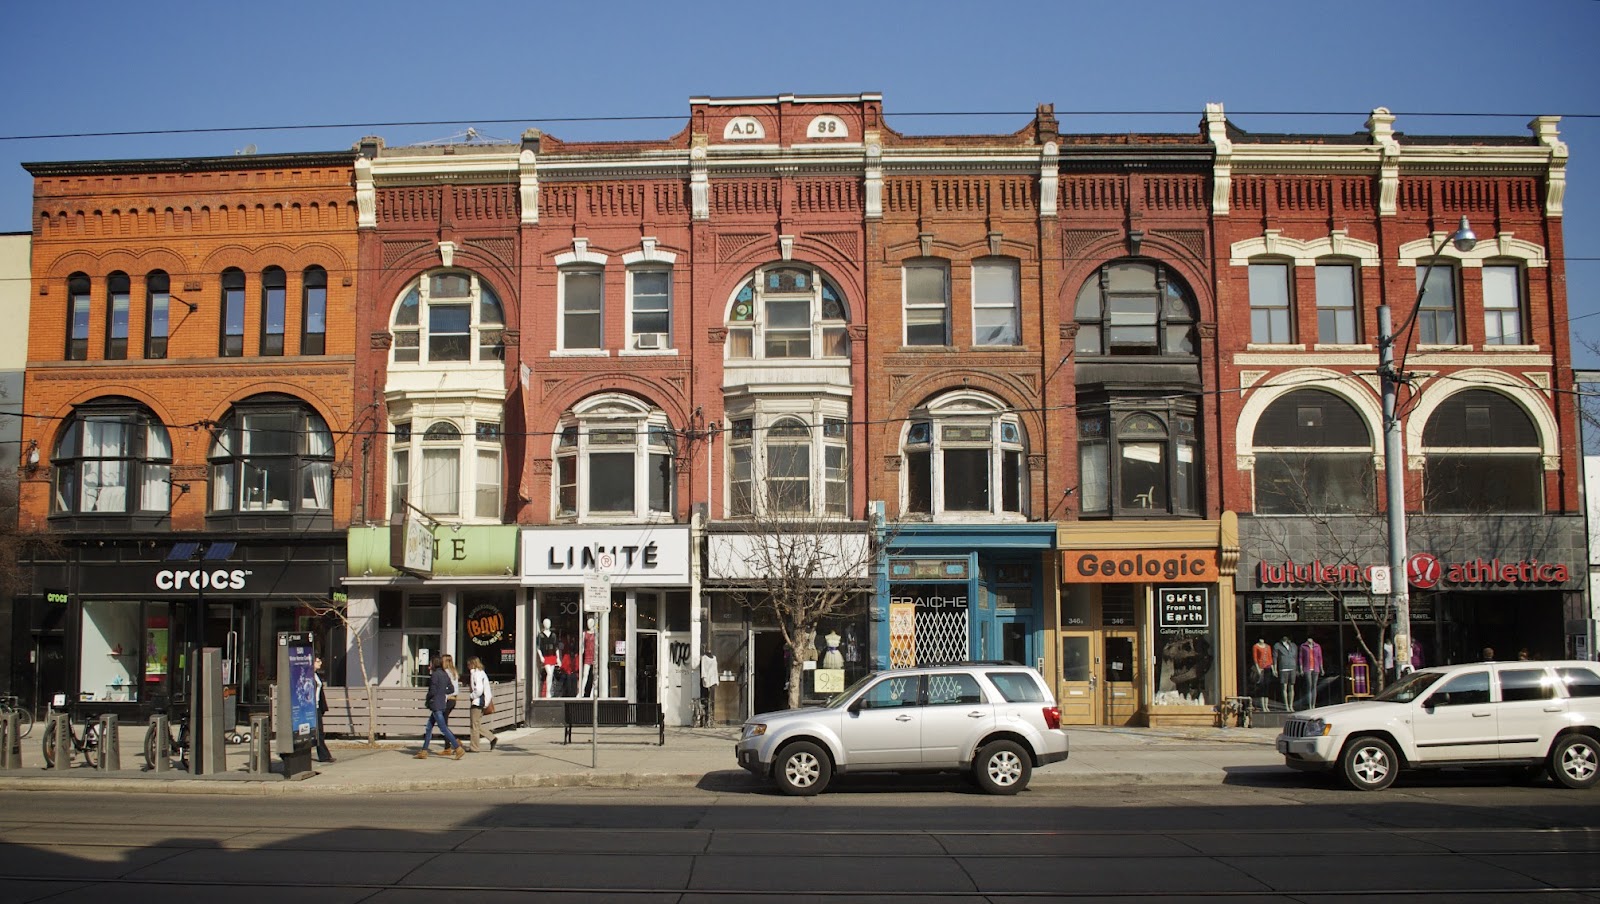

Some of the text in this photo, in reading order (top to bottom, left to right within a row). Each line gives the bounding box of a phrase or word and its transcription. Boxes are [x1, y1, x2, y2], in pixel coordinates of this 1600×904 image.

[731, 123, 757, 134] A.D.
[817, 121, 836, 133] 88
[548, 541, 659, 569] LIMTÉ
[1077, 554, 1206, 580] Geologic
[1260, 559, 1375, 584] lululem
[1448, 557, 1571, 583] athletica
[155, 570, 246, 590] crocs
[47, 593, 68, 603] crocs
[1166, 594, 1202, 603] Gifts
[1166, 612, 1203, 621] Earth
